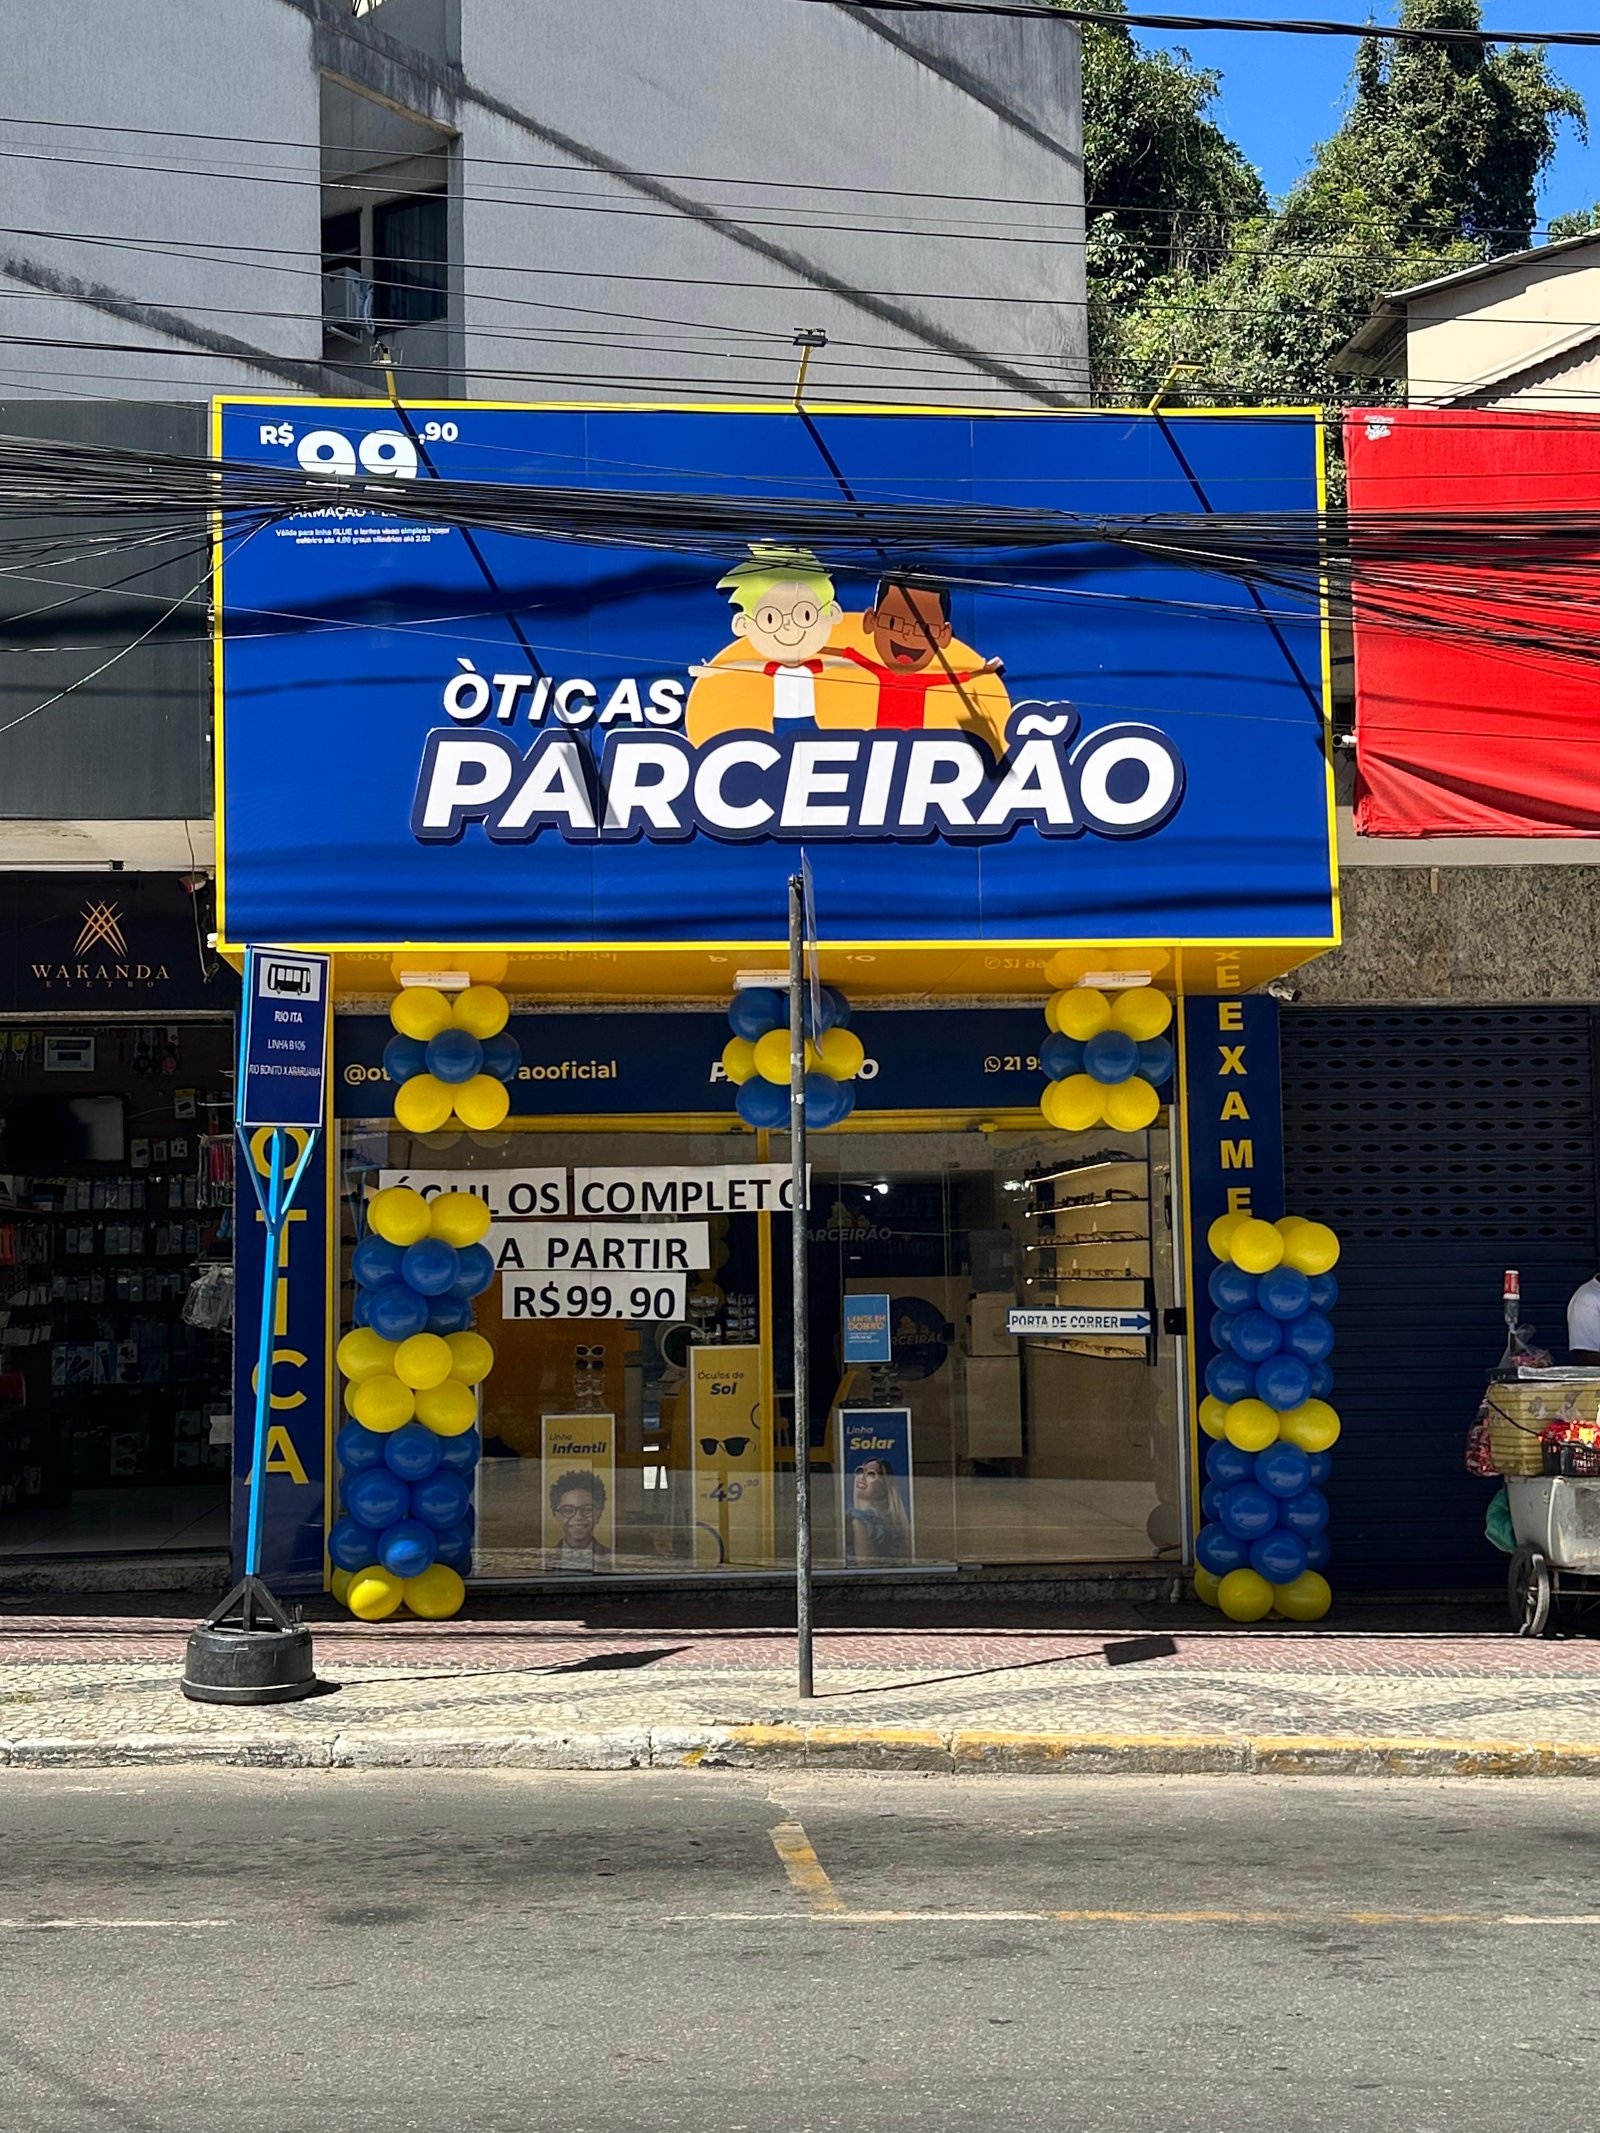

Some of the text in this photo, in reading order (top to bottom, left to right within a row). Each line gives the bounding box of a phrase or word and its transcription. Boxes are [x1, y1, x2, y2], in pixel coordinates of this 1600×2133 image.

[260, 423, 295, 446] R$
[297, 429, 418, 493] 99
[421, 715, 1176, 830] PARCEIRÃO
[32, 964, 170, 979] WAKANDA
[274, 1011, 303, 1024] RIO ITA
[267, 1039, 289, 1050] LINHA
[249, 1064, 260, 1074] RIO
[1004, 1056, 1021, 1071] 21
[1218, 1002, 1253, 1217] EXAME
[804, 1225, 893, 1243] ARCEIRÃO
[497, 1237, 689, 1270] A PARTIR
[514, 1281, 676, 1319] R$99.90
[1011, 1315, 1119, 1329] PORTA DE CORRER
[710, 1382, 738, 1395] Sol
[847, 1425, 874, 1435] Linha
[552, 1441, 607, 1455] Infantil
[850, 1436, 896, 1450] Solar
